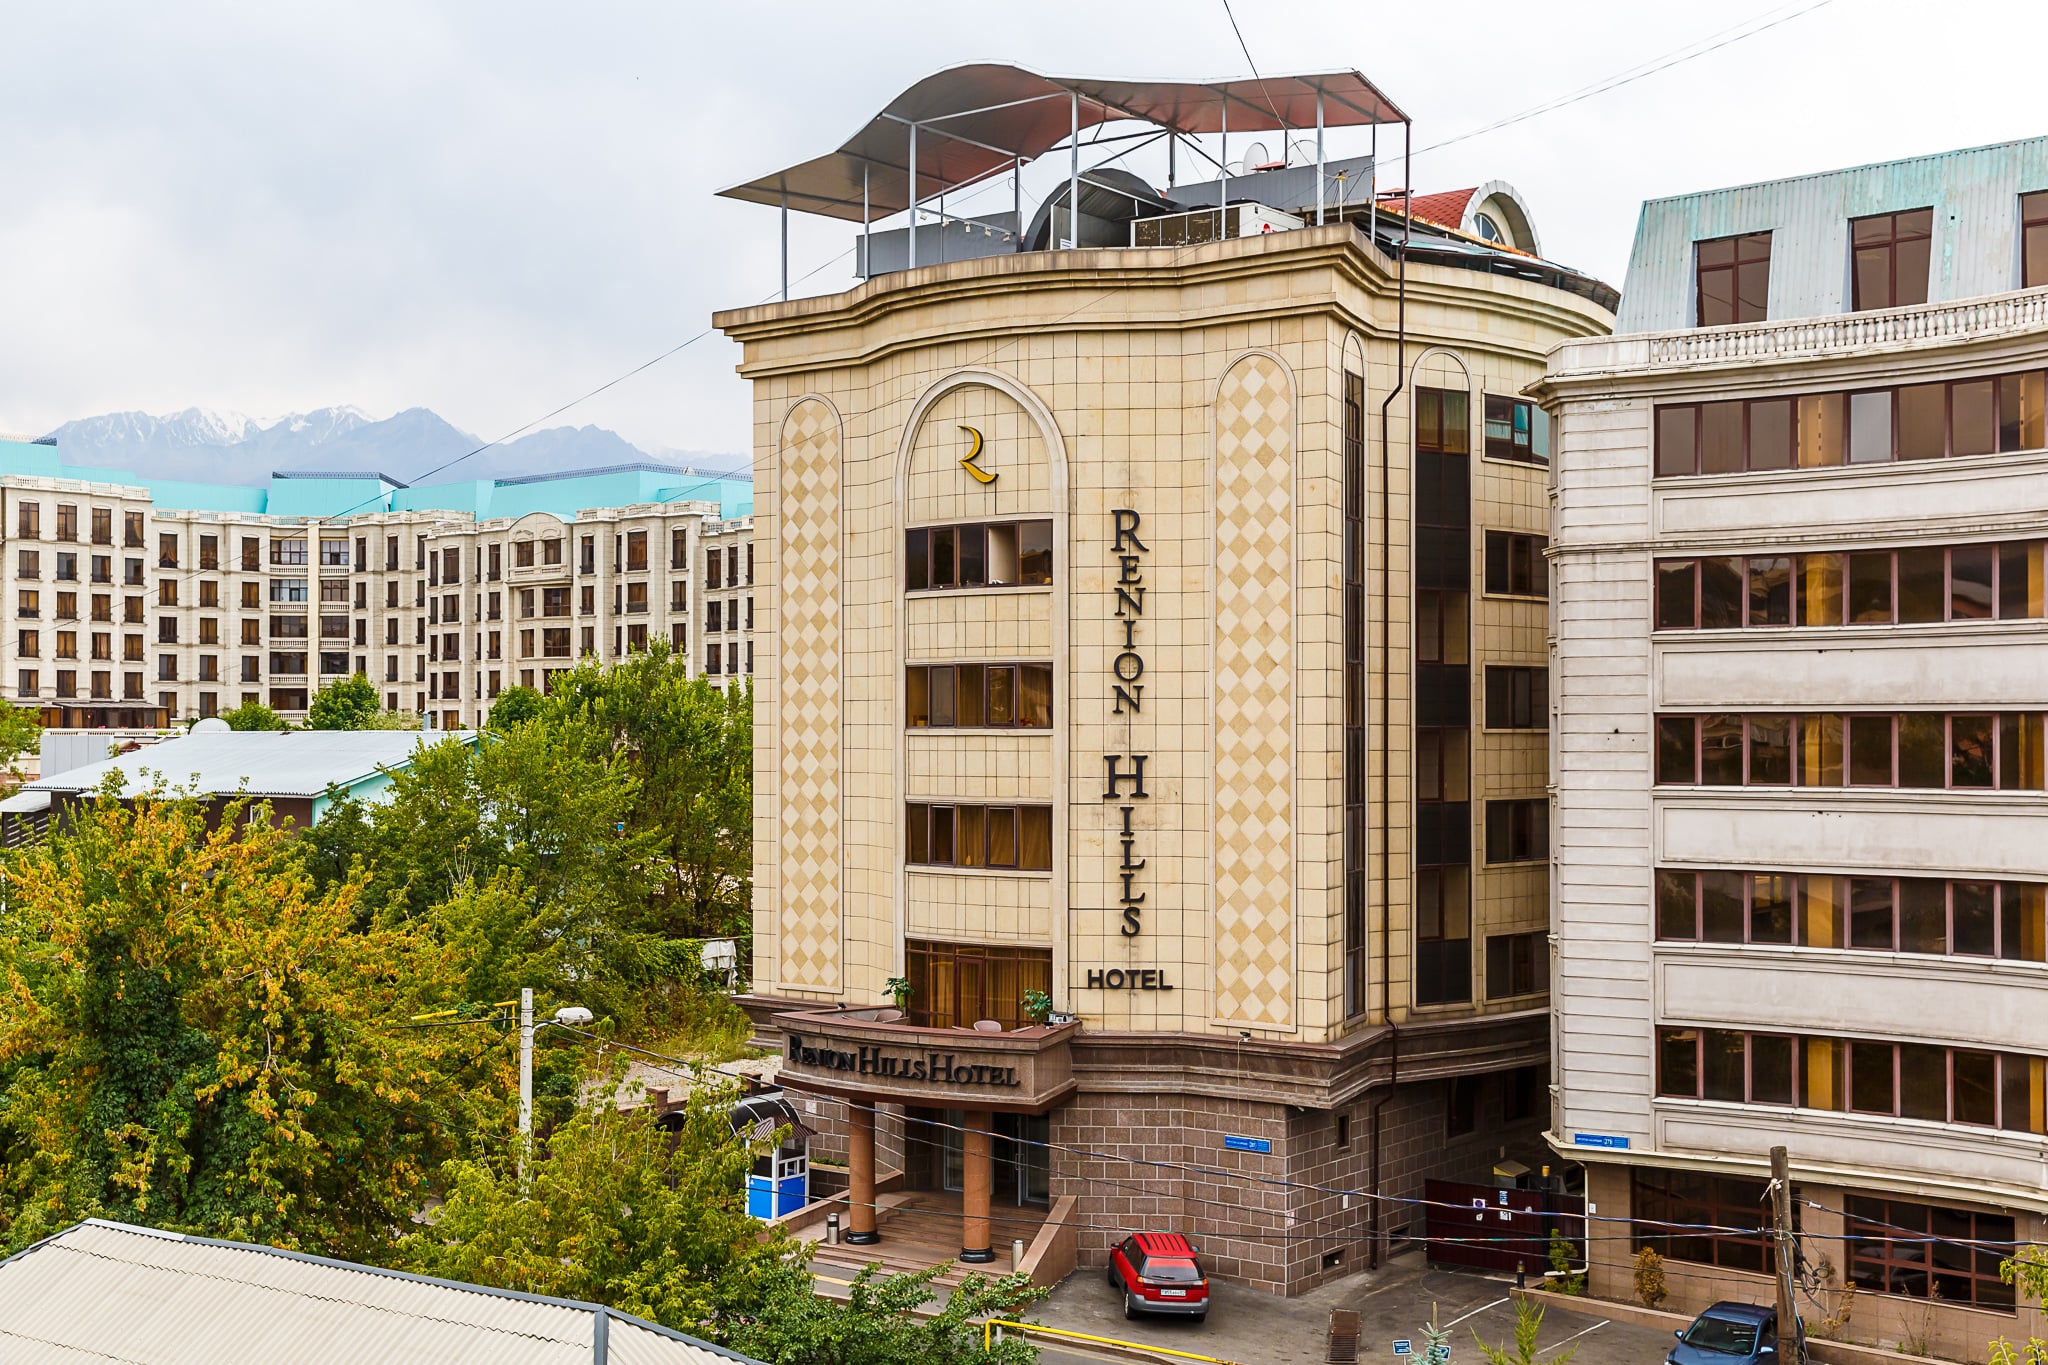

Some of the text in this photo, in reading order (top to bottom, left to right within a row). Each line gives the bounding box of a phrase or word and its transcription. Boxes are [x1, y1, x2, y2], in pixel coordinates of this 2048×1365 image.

[1102, 508, 1150, 938] RENION HILLS
[1087, 968, 1174, 990] HOTEL
[928, 1052, 1021, 1087] HOTEL
